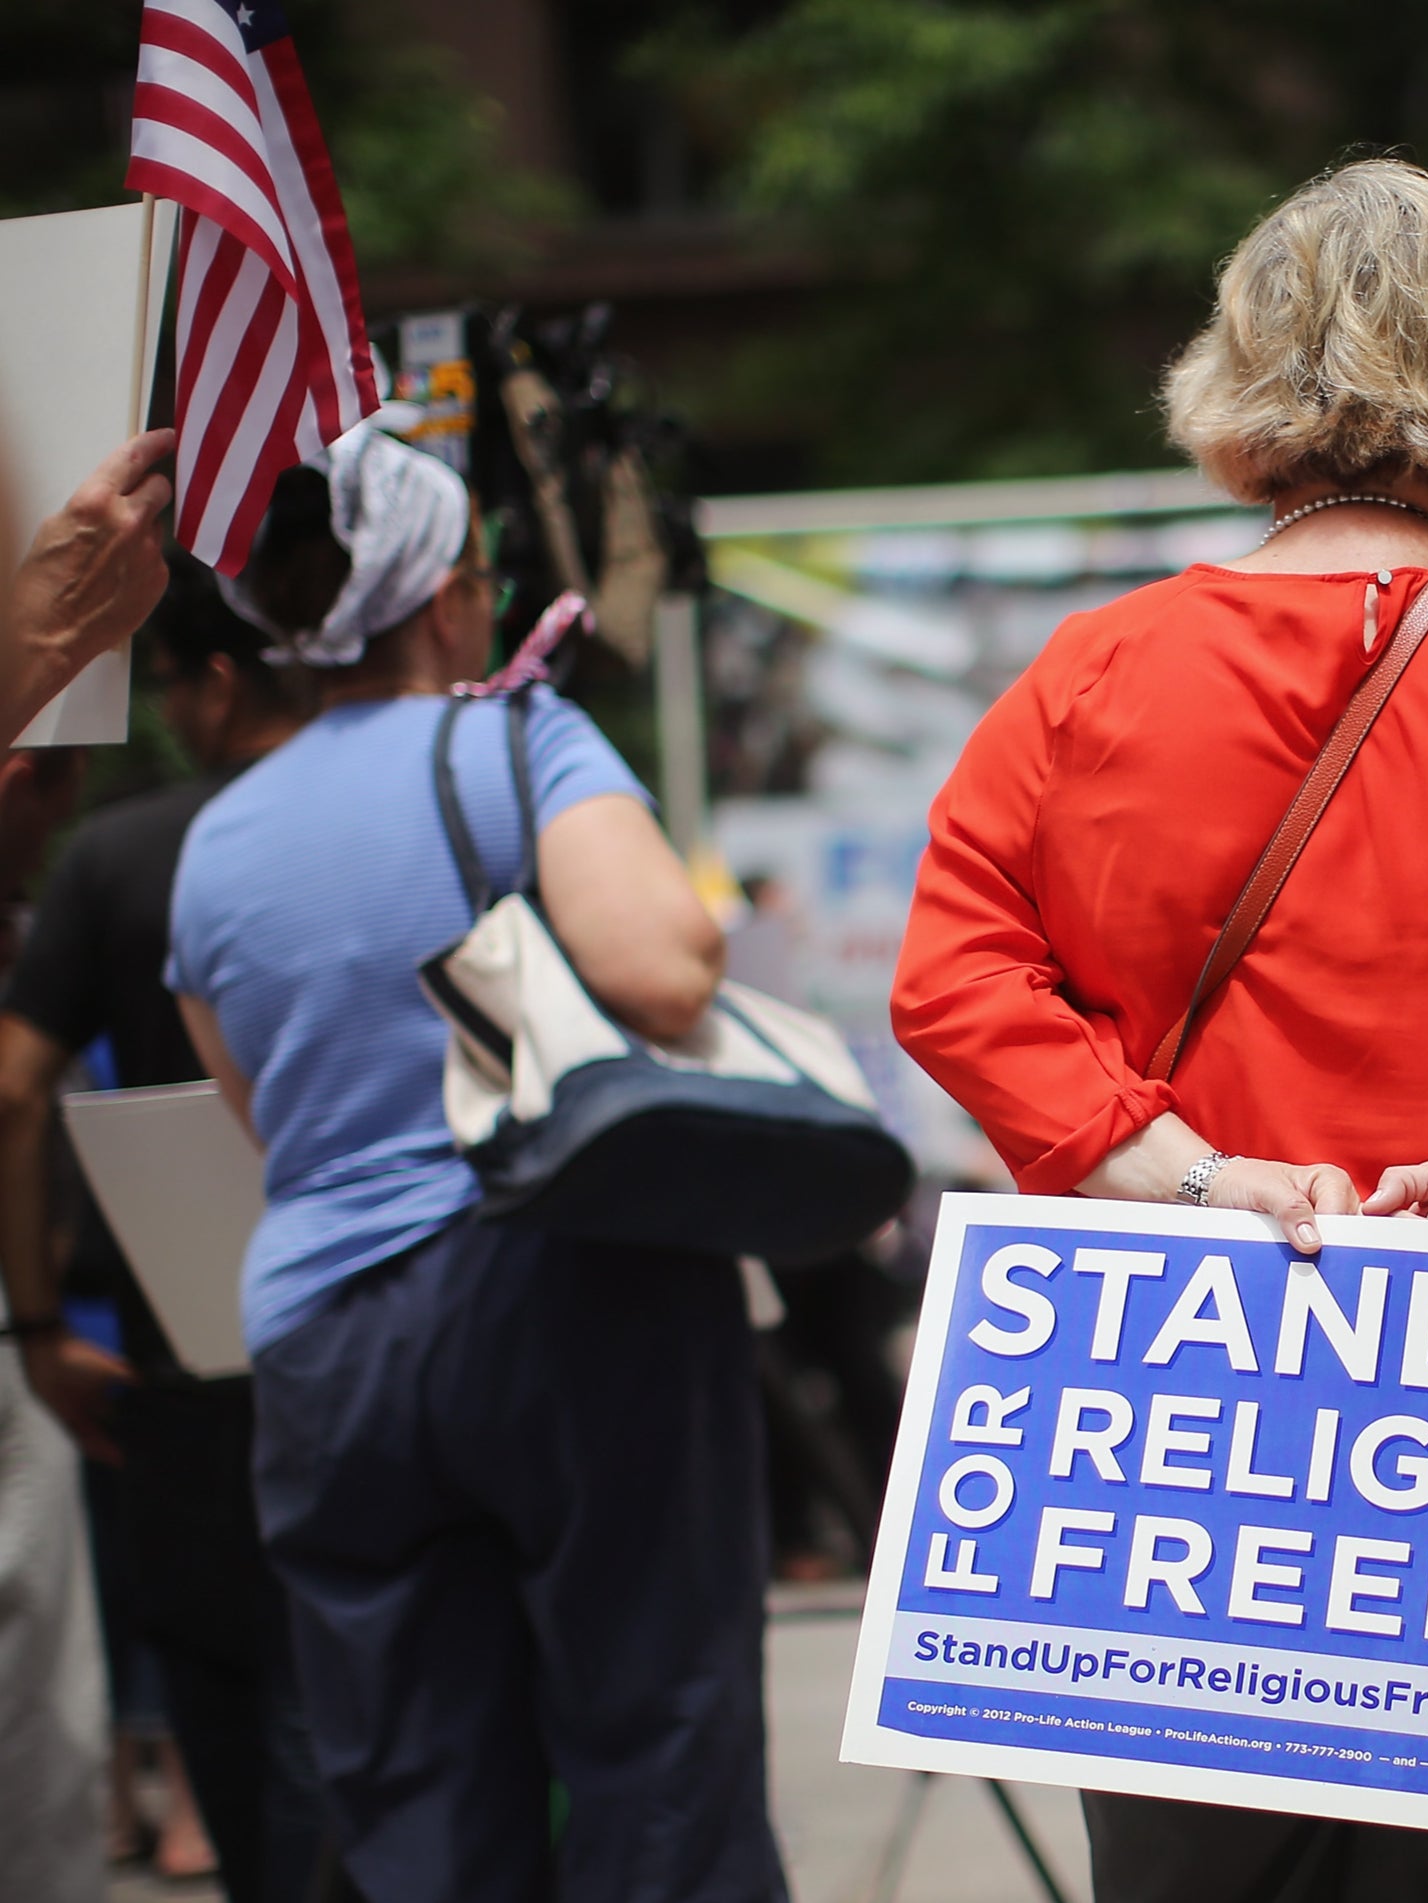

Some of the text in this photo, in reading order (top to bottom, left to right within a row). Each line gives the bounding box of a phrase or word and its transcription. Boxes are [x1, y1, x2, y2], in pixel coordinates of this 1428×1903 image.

[924, 1385, 1030, 1592] FOR
[907, 1701, 967, 1718] Copyright
[982, 1708, 1011, 1721] 2012
[1013, 1712, 1062, 1727] Pro-Life
[1064, 1717, 1105, 1731] Action
[1107, 1722, 1152, 1737] League
[1164, 1728, 1272, 1752] ProLifeAction.org
[1285, 1741, 1372, 1762] 773-777-2900
